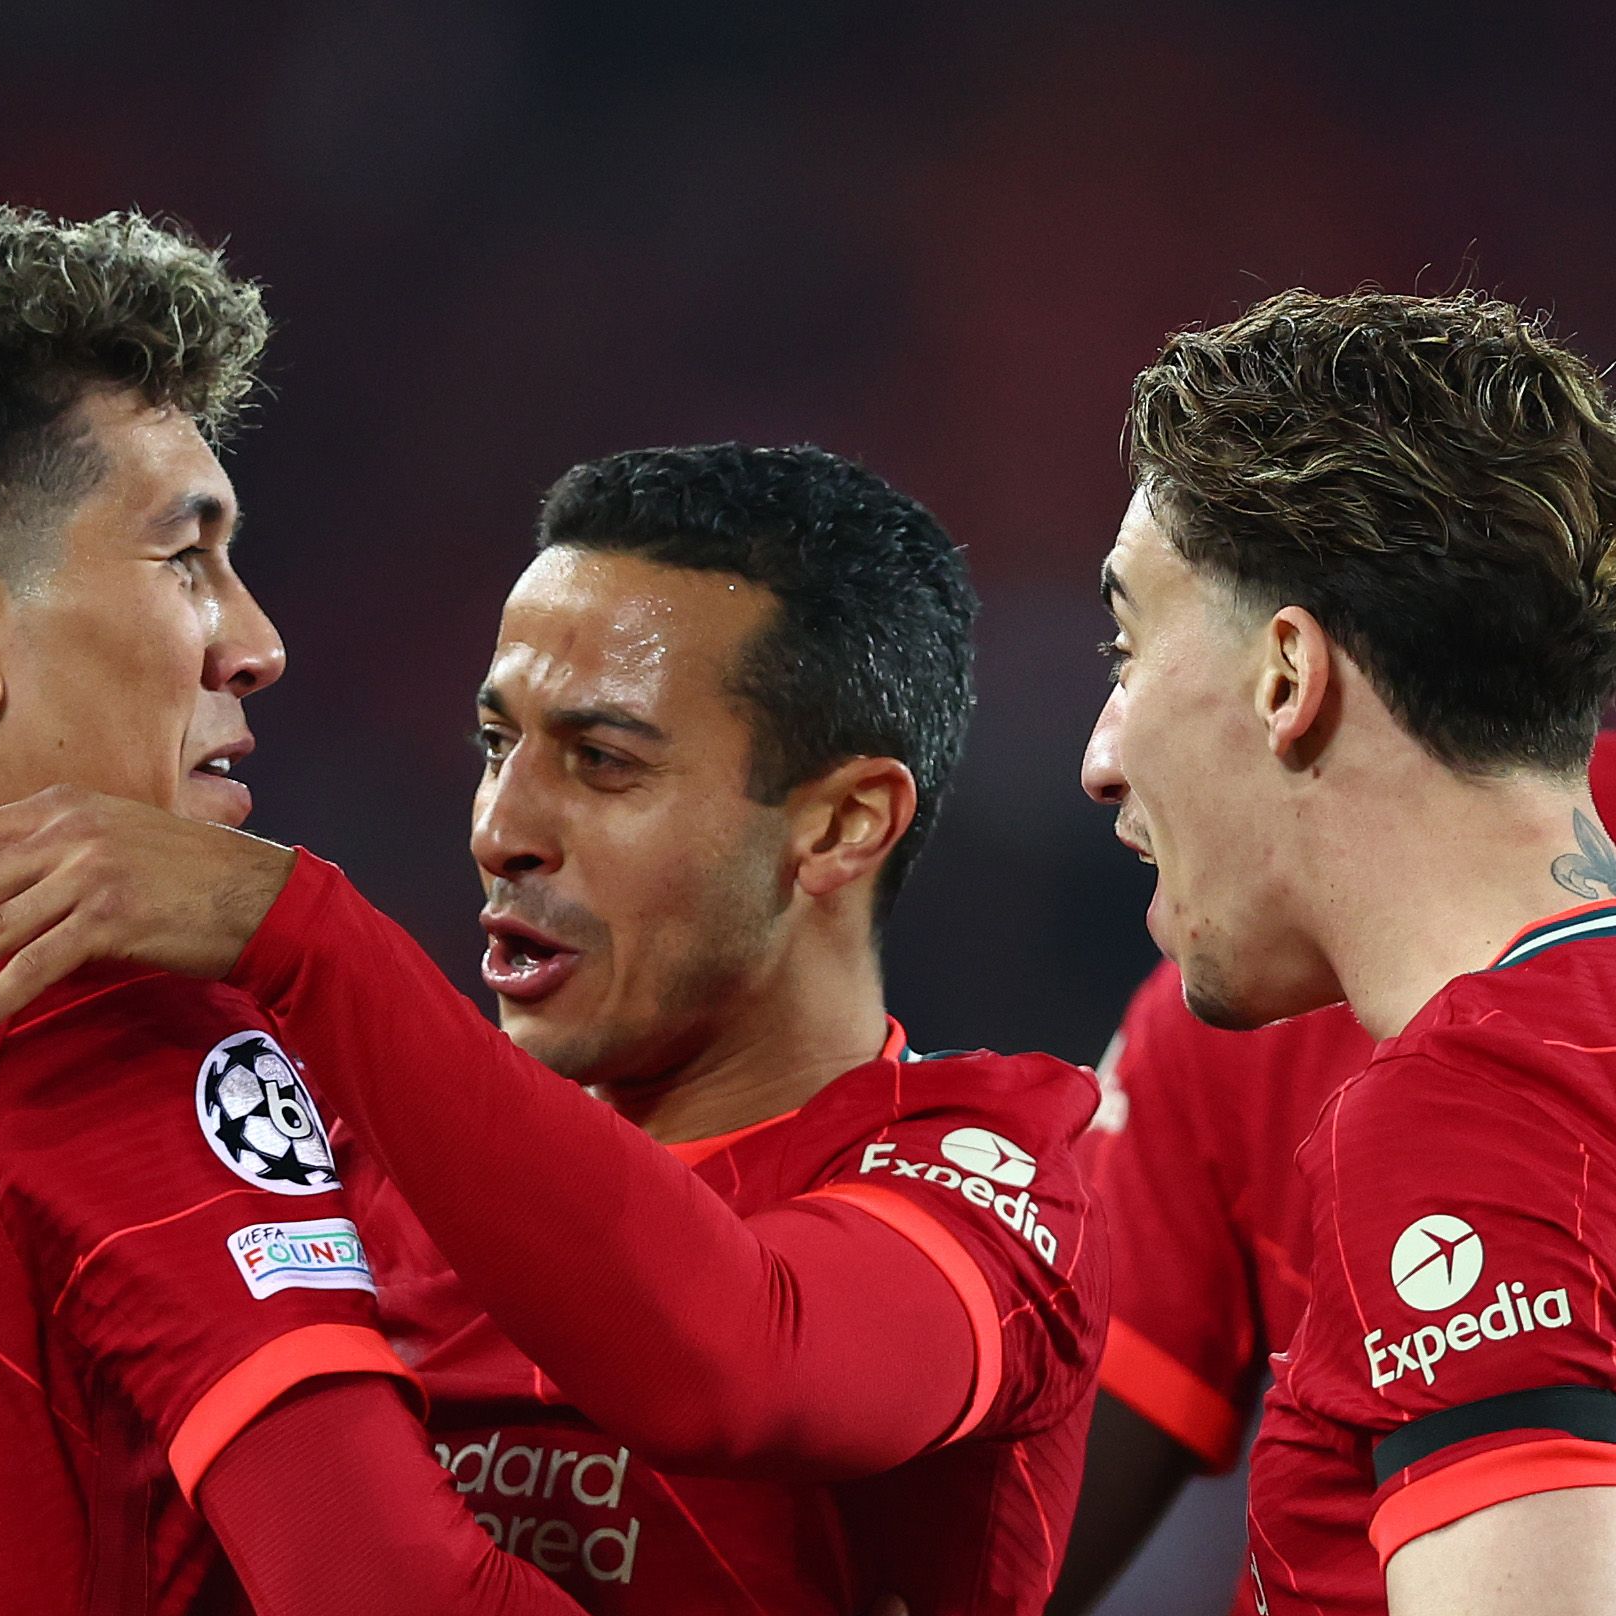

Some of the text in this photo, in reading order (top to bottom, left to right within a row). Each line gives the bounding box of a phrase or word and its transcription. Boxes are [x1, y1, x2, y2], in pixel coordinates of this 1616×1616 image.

[264, 1081, 313, 1139] 6
[237, 1226, 286, 1251] UEFA
[1364, 1281, 1572, 1388] Expedia
